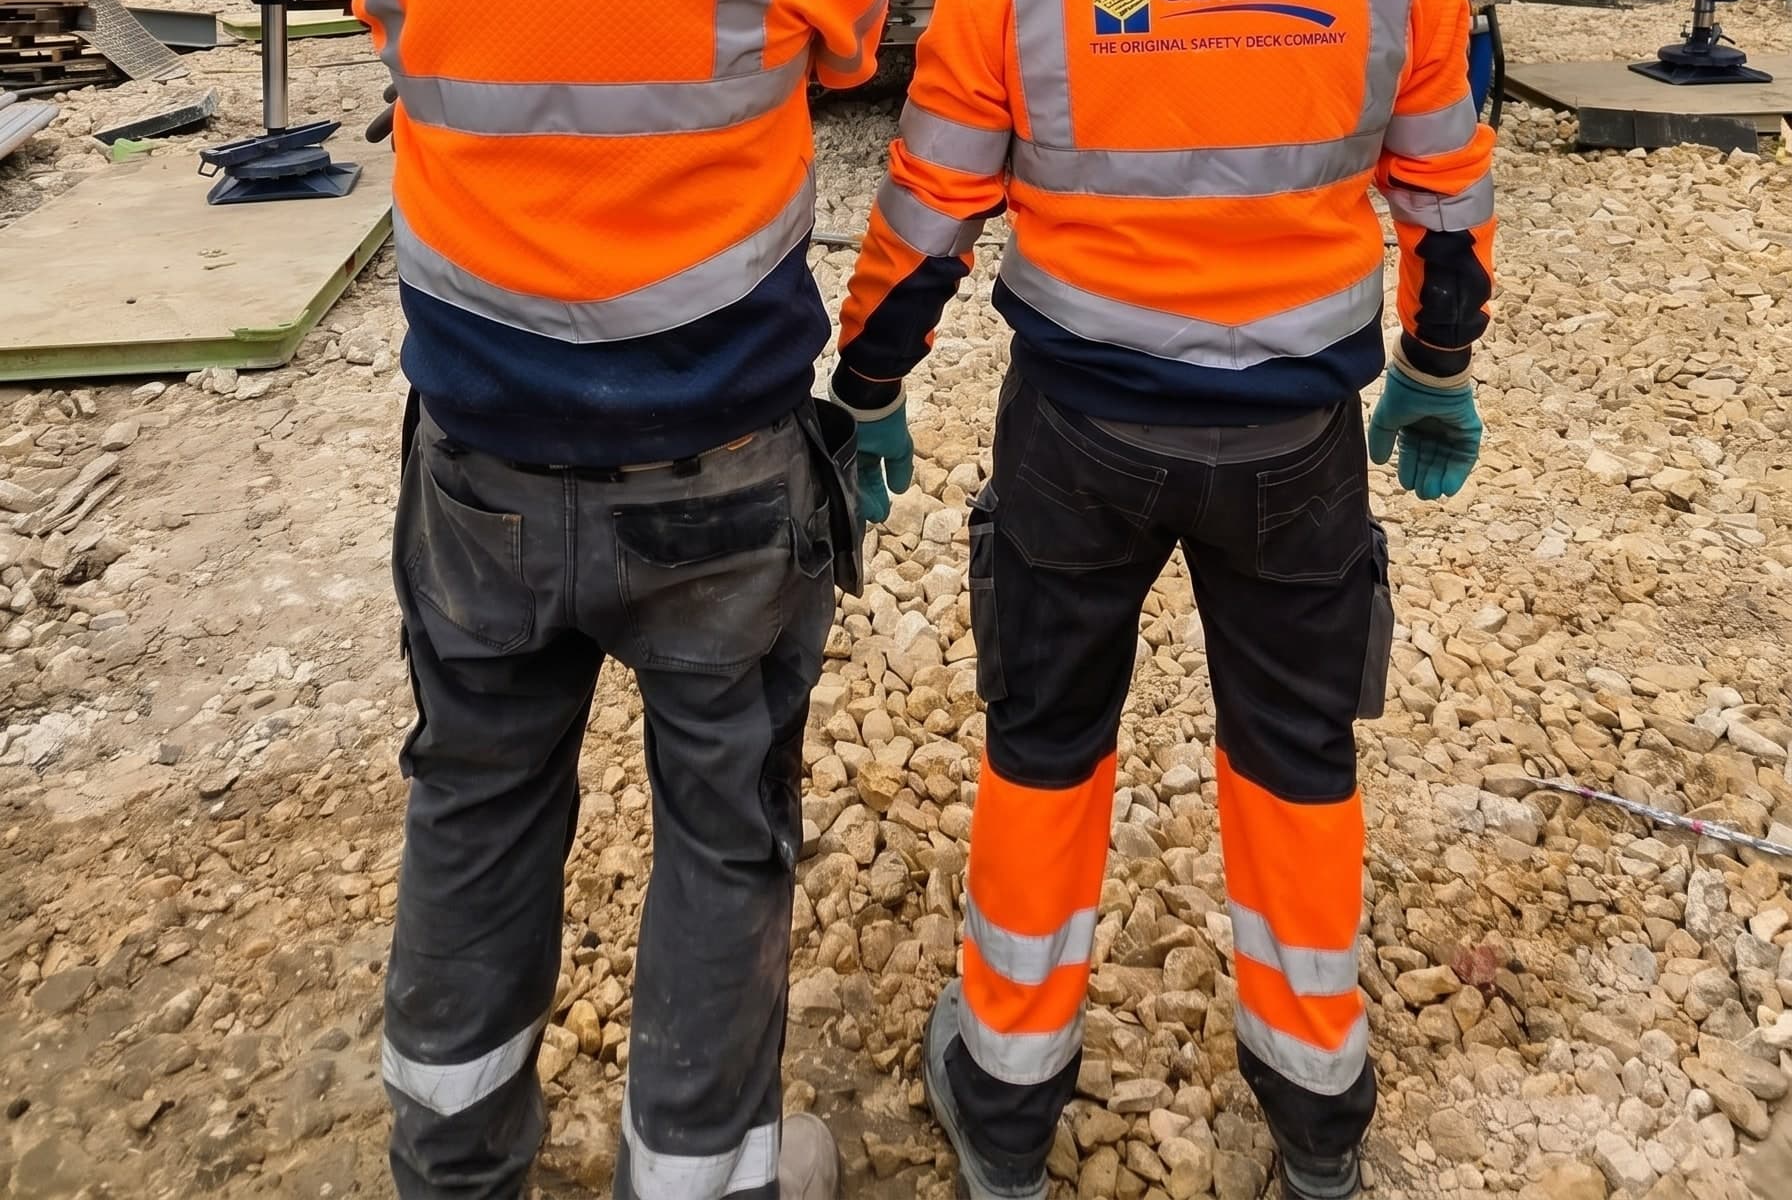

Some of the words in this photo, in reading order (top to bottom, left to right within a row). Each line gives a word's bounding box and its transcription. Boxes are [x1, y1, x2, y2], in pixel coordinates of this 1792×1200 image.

[1090, 42, 1117, 54] THE
[1120, 39, 1187, 53] ORIGINAL
[1191, 36, 1241, 50] SAFETY
[1246, 34, 1282, 48] DECK
[1284, 31, 1347, 46] COMPANY
